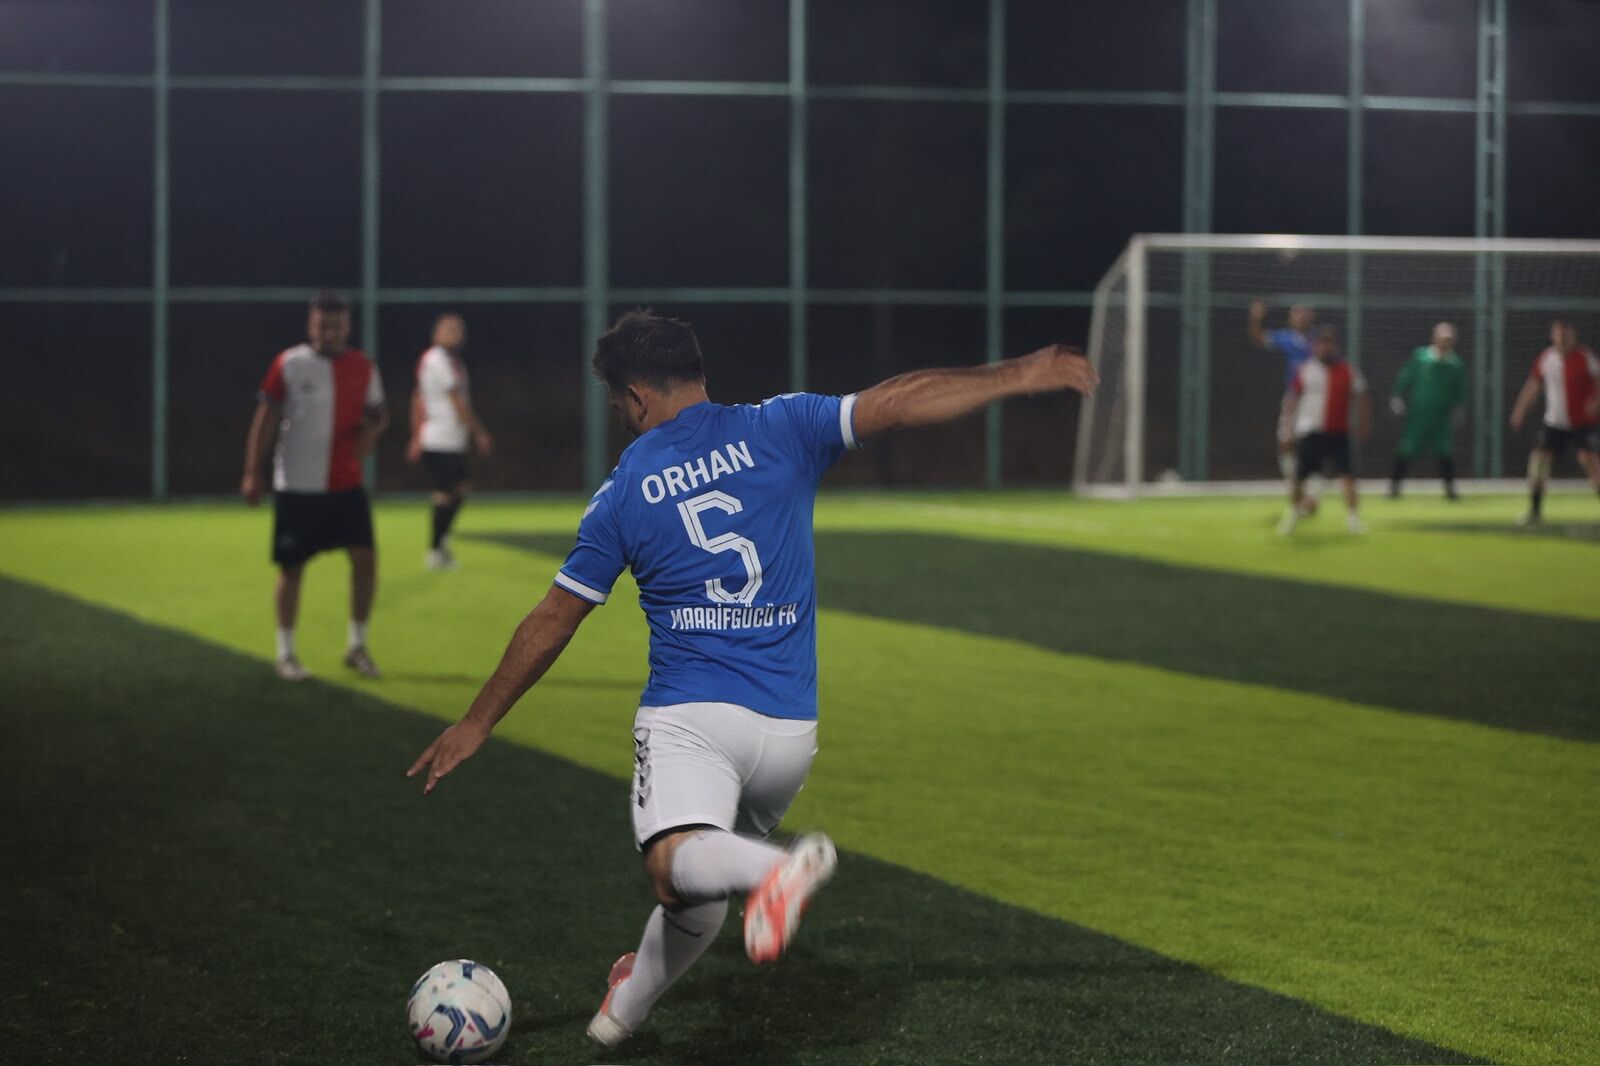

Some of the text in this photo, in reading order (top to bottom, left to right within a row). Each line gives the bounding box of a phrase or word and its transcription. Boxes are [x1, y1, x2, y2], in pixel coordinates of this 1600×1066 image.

[641, 440, 755, 504] ORHAN
[677, 490, 763, 604] 5
[670, 603, 797, 630] MAARİFGÜCÜ FK
